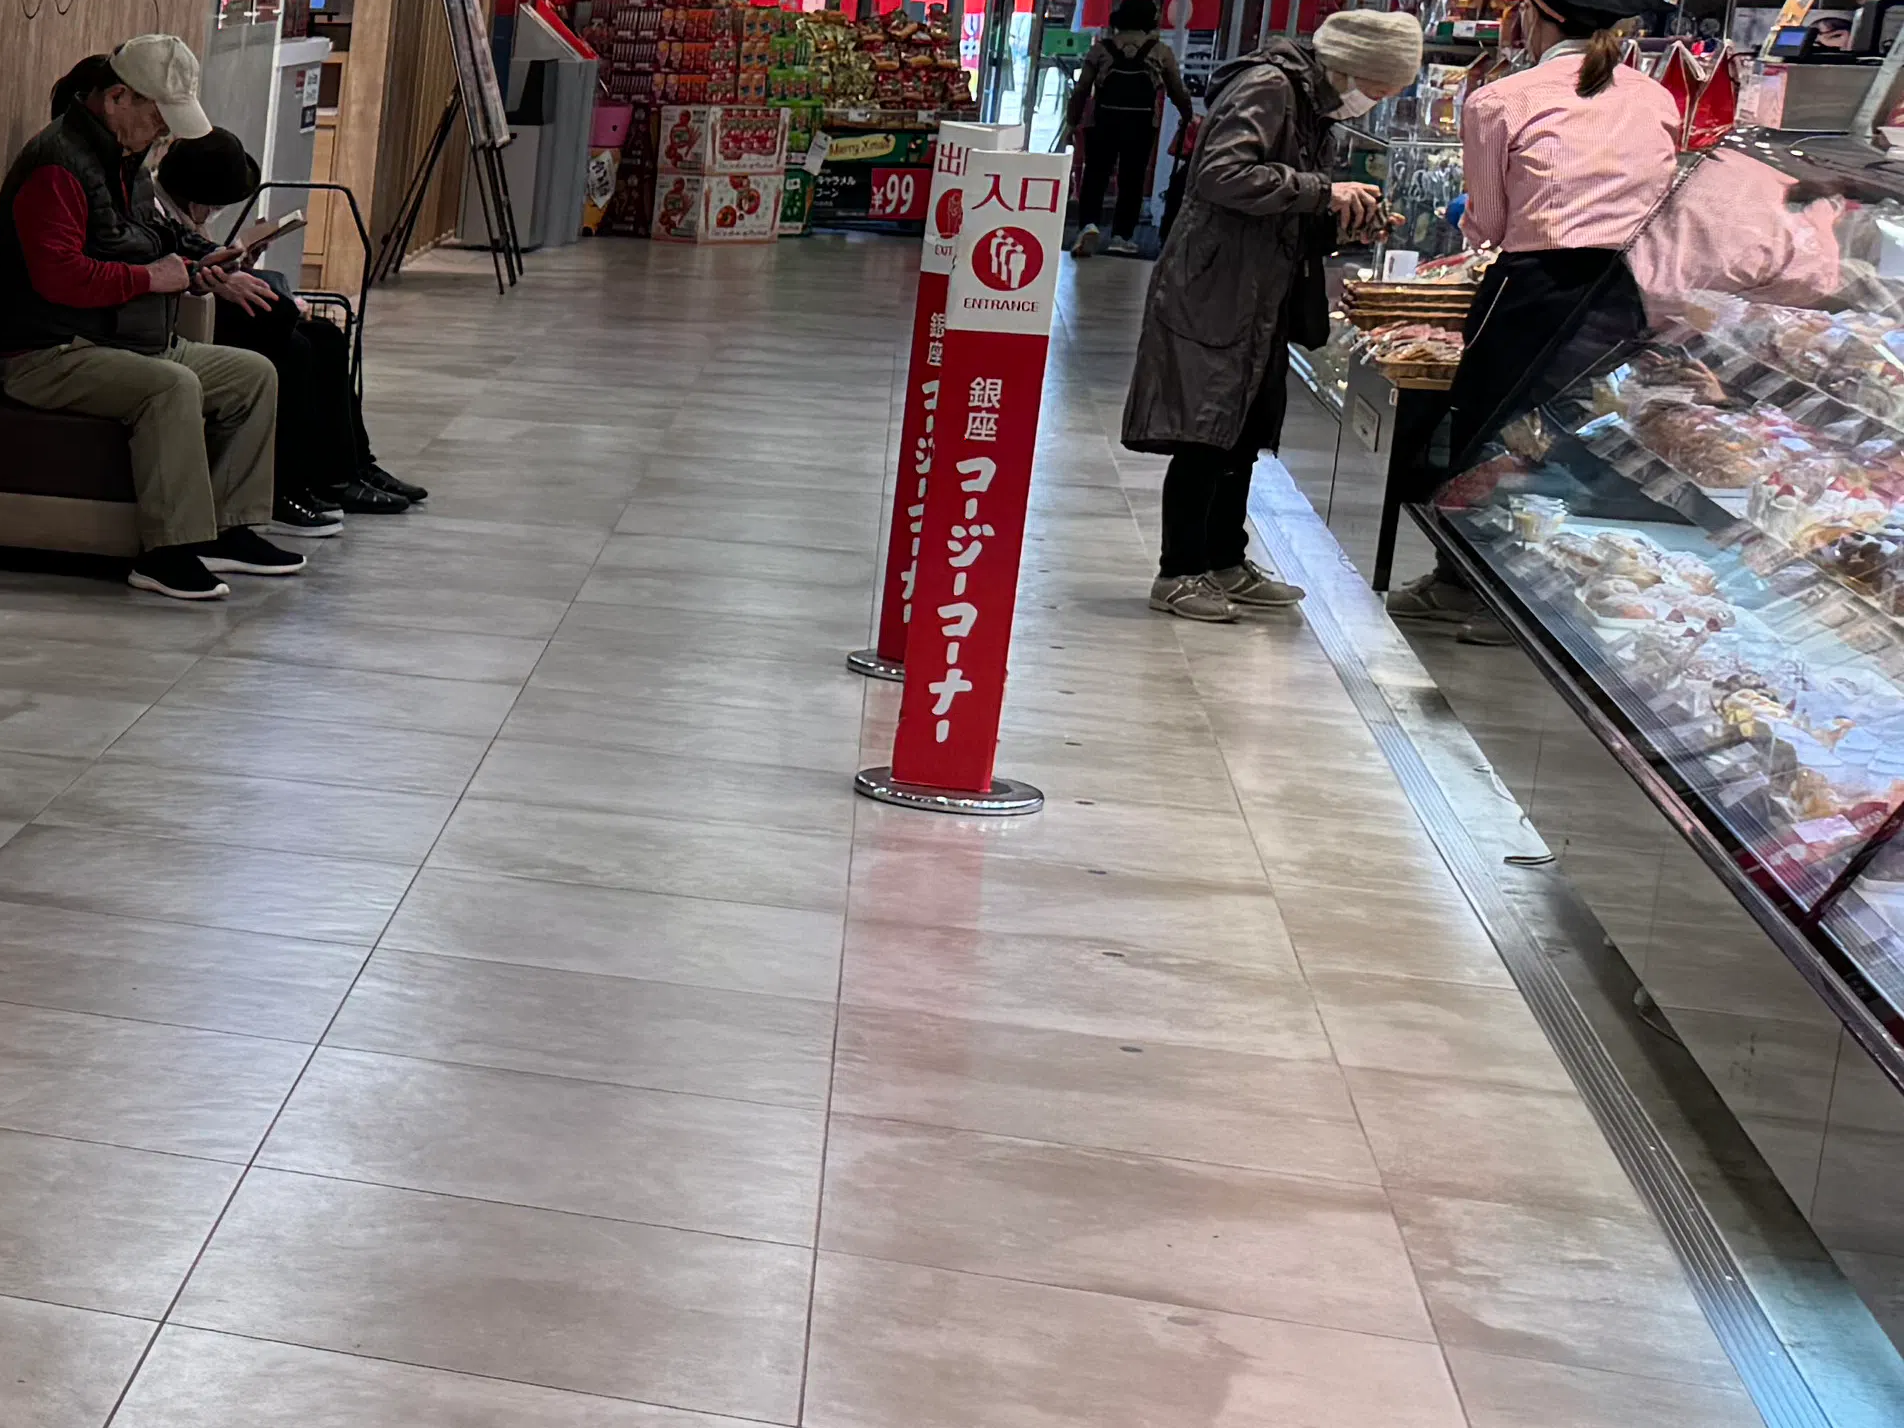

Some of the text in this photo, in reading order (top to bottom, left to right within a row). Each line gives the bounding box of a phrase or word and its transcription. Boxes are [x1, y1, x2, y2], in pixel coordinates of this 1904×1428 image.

[828, 139, 863, 157] Merry
[871, 173, 915, 216] ¥99
[971, 173, 1061, 214] 入口
[963, 296, 1040, 313] ENTRANCE
[964, 375, 1003, 443] 銀座
[926, 454, 998, 745] コージーコーナー
